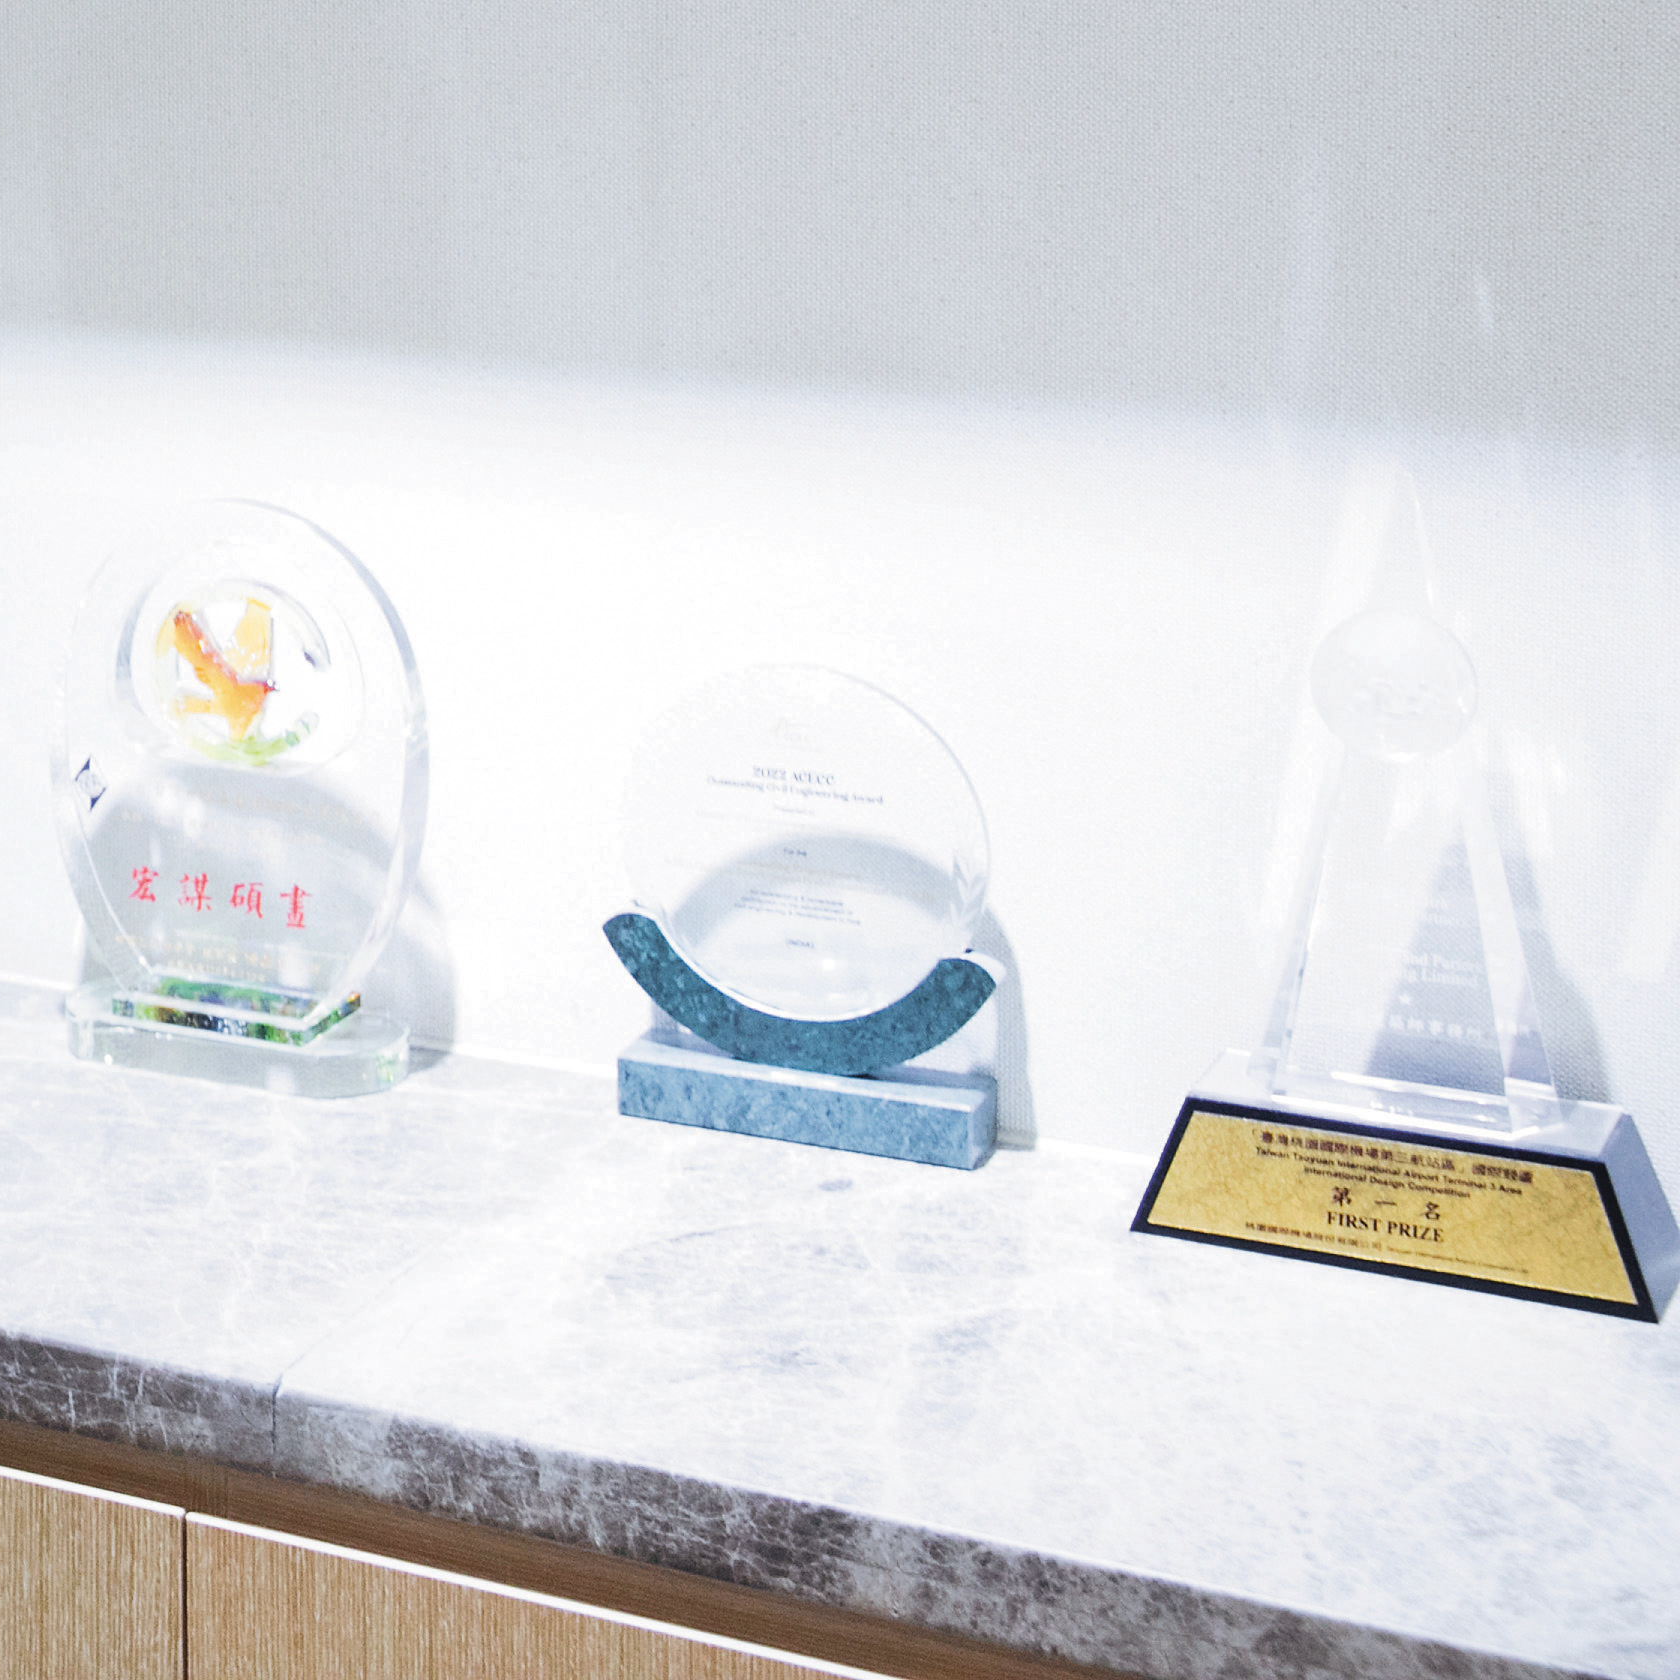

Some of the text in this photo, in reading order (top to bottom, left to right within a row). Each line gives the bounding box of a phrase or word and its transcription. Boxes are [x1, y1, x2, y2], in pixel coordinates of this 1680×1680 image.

[752, 765, 787, 782] 2022
[1256, 1146, 1290, 1159] Taiwan
[1293, 1152, 1335, 1167] Taoyuan
[1337, 1159, 1401, 1176] International
[1404, 1169, 1439, 1182] Airport
[1443, 1175, 1487, 1189] Terminal
[1499, 1184, 1522, 1195] Area
[1304, 1166, 1471, 1199] International Design Competition
[1332, 1186, 1441, 1220] 第一名
[1327, 1211, 1444, 1242] FIRST PRIZE
